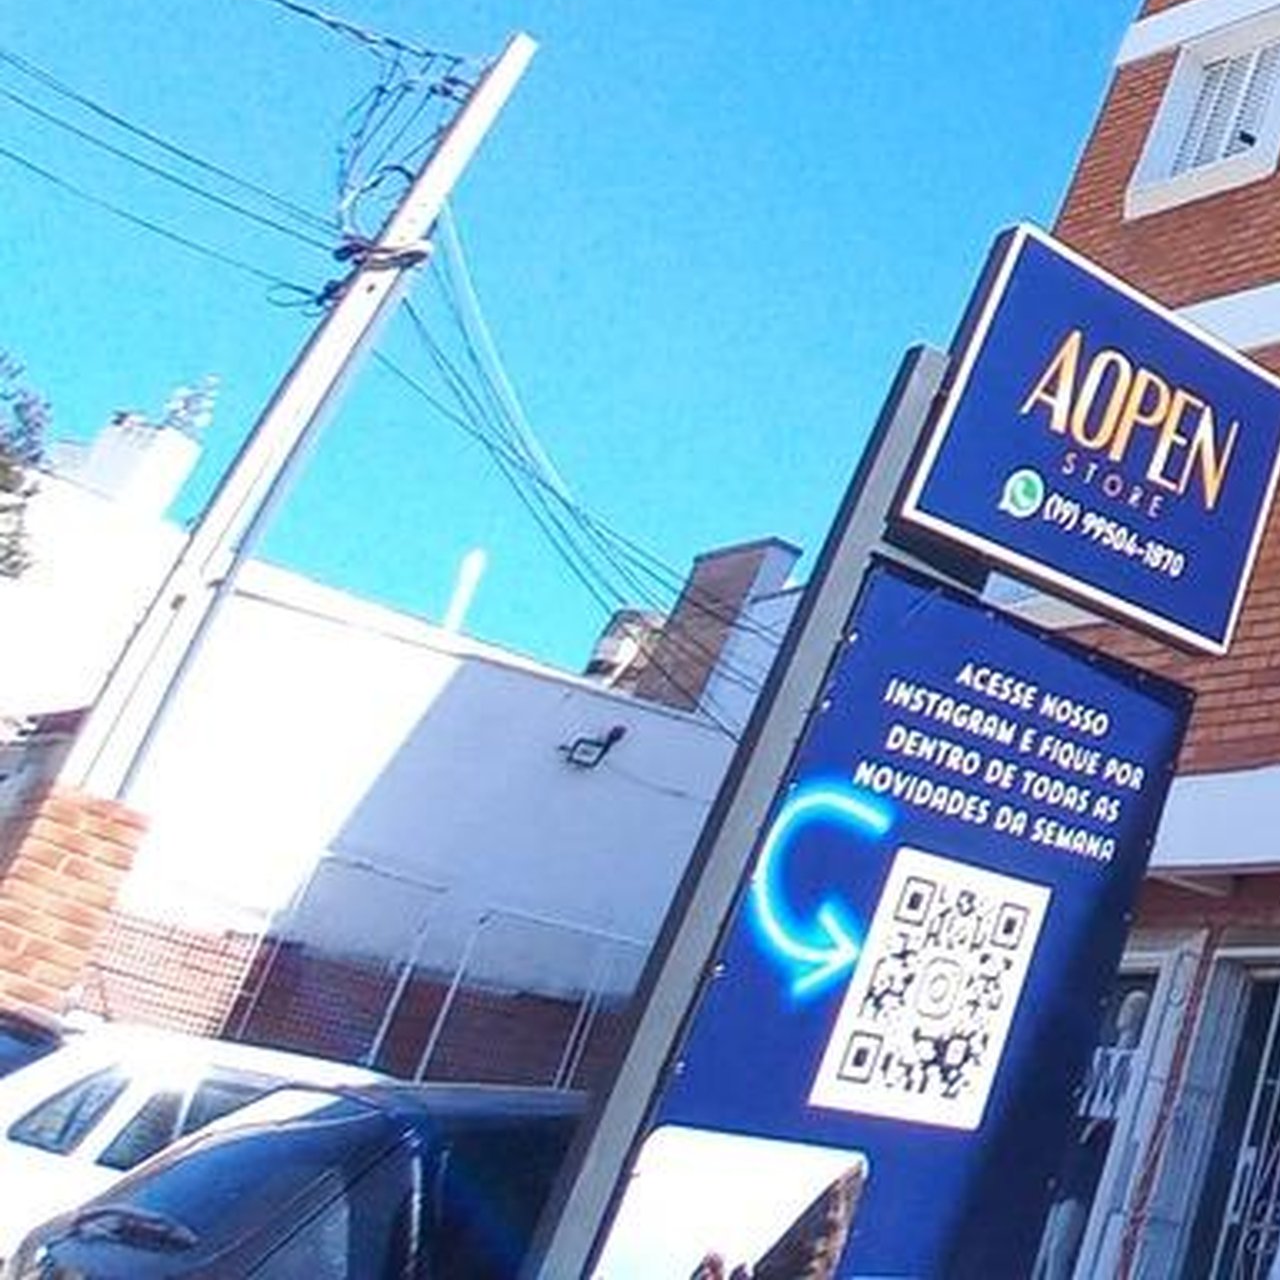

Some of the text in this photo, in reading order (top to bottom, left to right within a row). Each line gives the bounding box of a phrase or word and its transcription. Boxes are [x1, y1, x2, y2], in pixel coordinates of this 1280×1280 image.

[1021, 329, 1239, 510] AOPEN
[1062, 451, 1164, 518] STORE
[884, 678, 1145, 791] INSTAGRAM E FIQUE POR
[956, 663, 1110, 737] ACESSE NOSSO
[852, 761, 1117, 863] NOVIDADES DA SEMANA
[885, 725, 1121, 823] DENTRO DE TODAS AS
